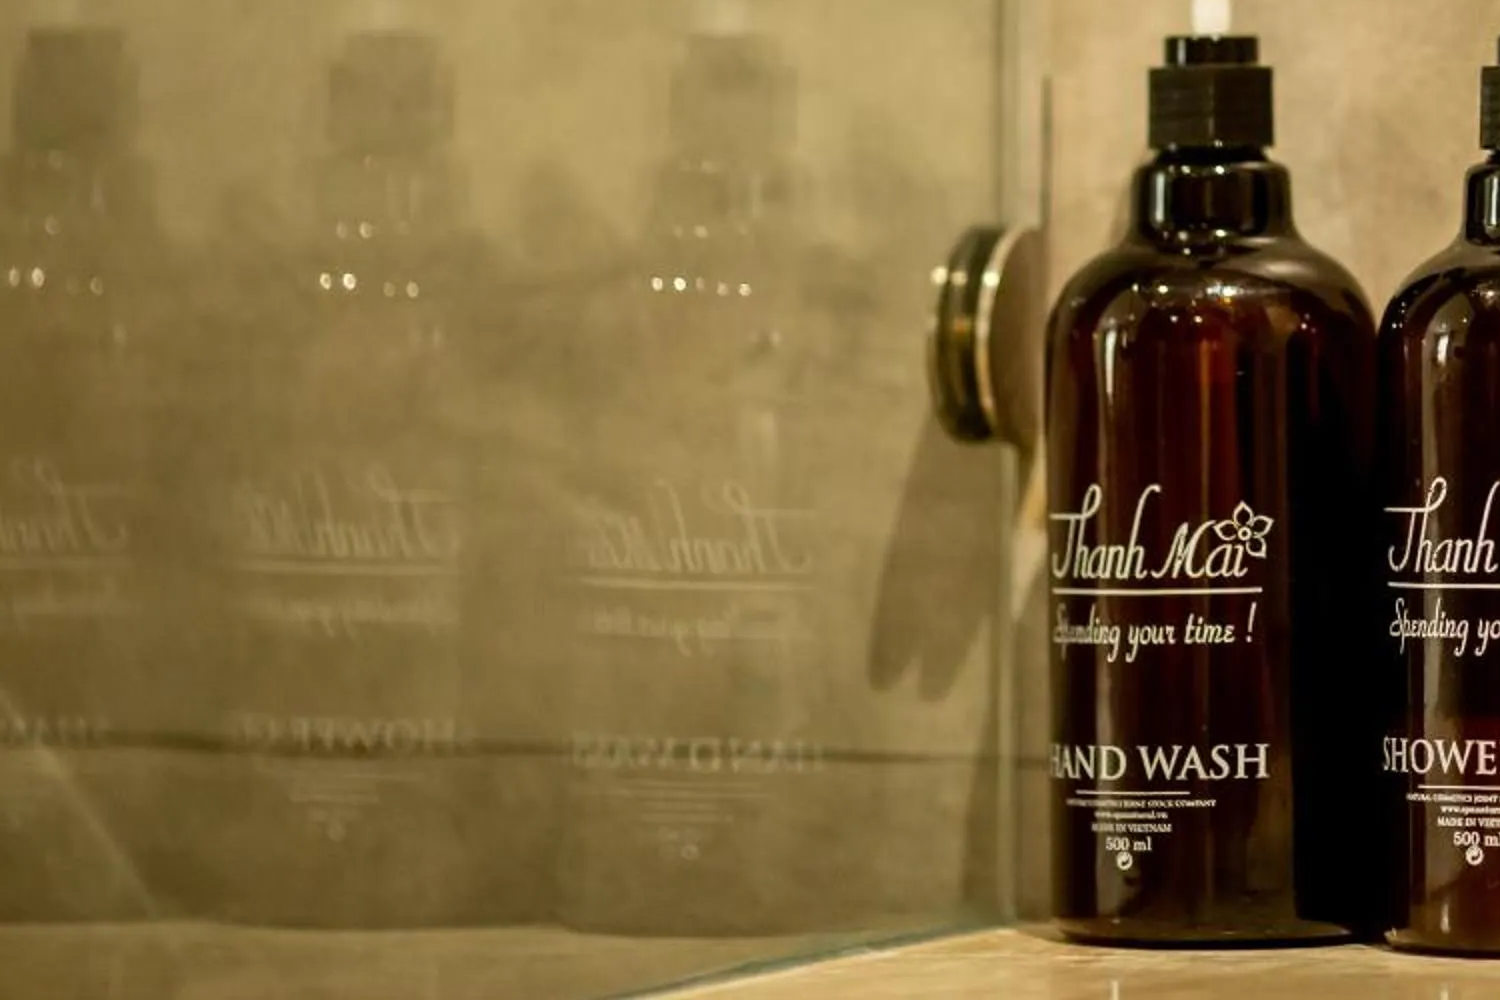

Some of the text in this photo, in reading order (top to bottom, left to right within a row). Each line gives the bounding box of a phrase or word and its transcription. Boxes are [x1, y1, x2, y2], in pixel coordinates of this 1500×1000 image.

[1049, 484, 1249, 579] Thanh Mai
[1126, 624, 1176, 663] your
[1185, 613, 1235, 645] time
[1389, 597, 1469, 656] Spending
[1136, 743, 1271, 781] WASH
[1105, 836, 1152, 851] 500 ml
[1453, 831, 1480, 846] 500
